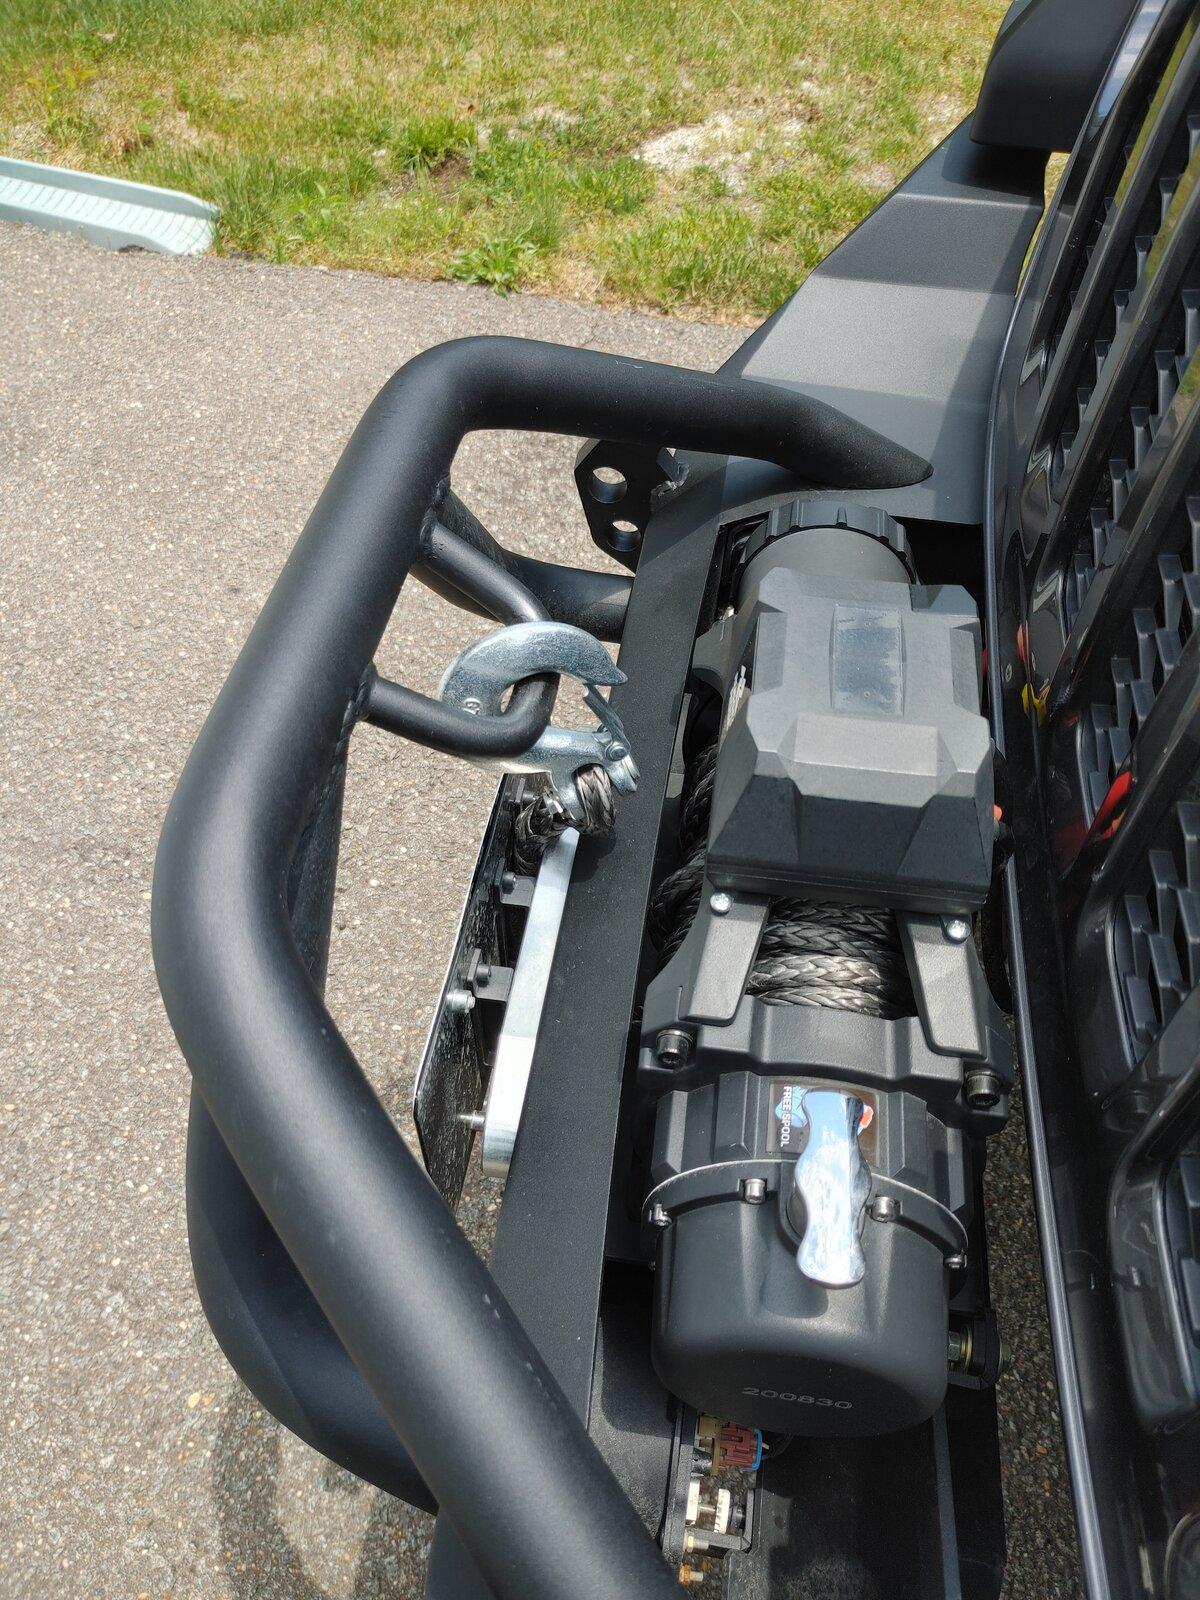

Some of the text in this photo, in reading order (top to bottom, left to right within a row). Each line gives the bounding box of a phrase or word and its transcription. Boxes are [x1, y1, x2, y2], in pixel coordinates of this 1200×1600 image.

[781, 1086, 792, 1147] FREE SPOOL
[742, 1387, 852, 1409] 200830
